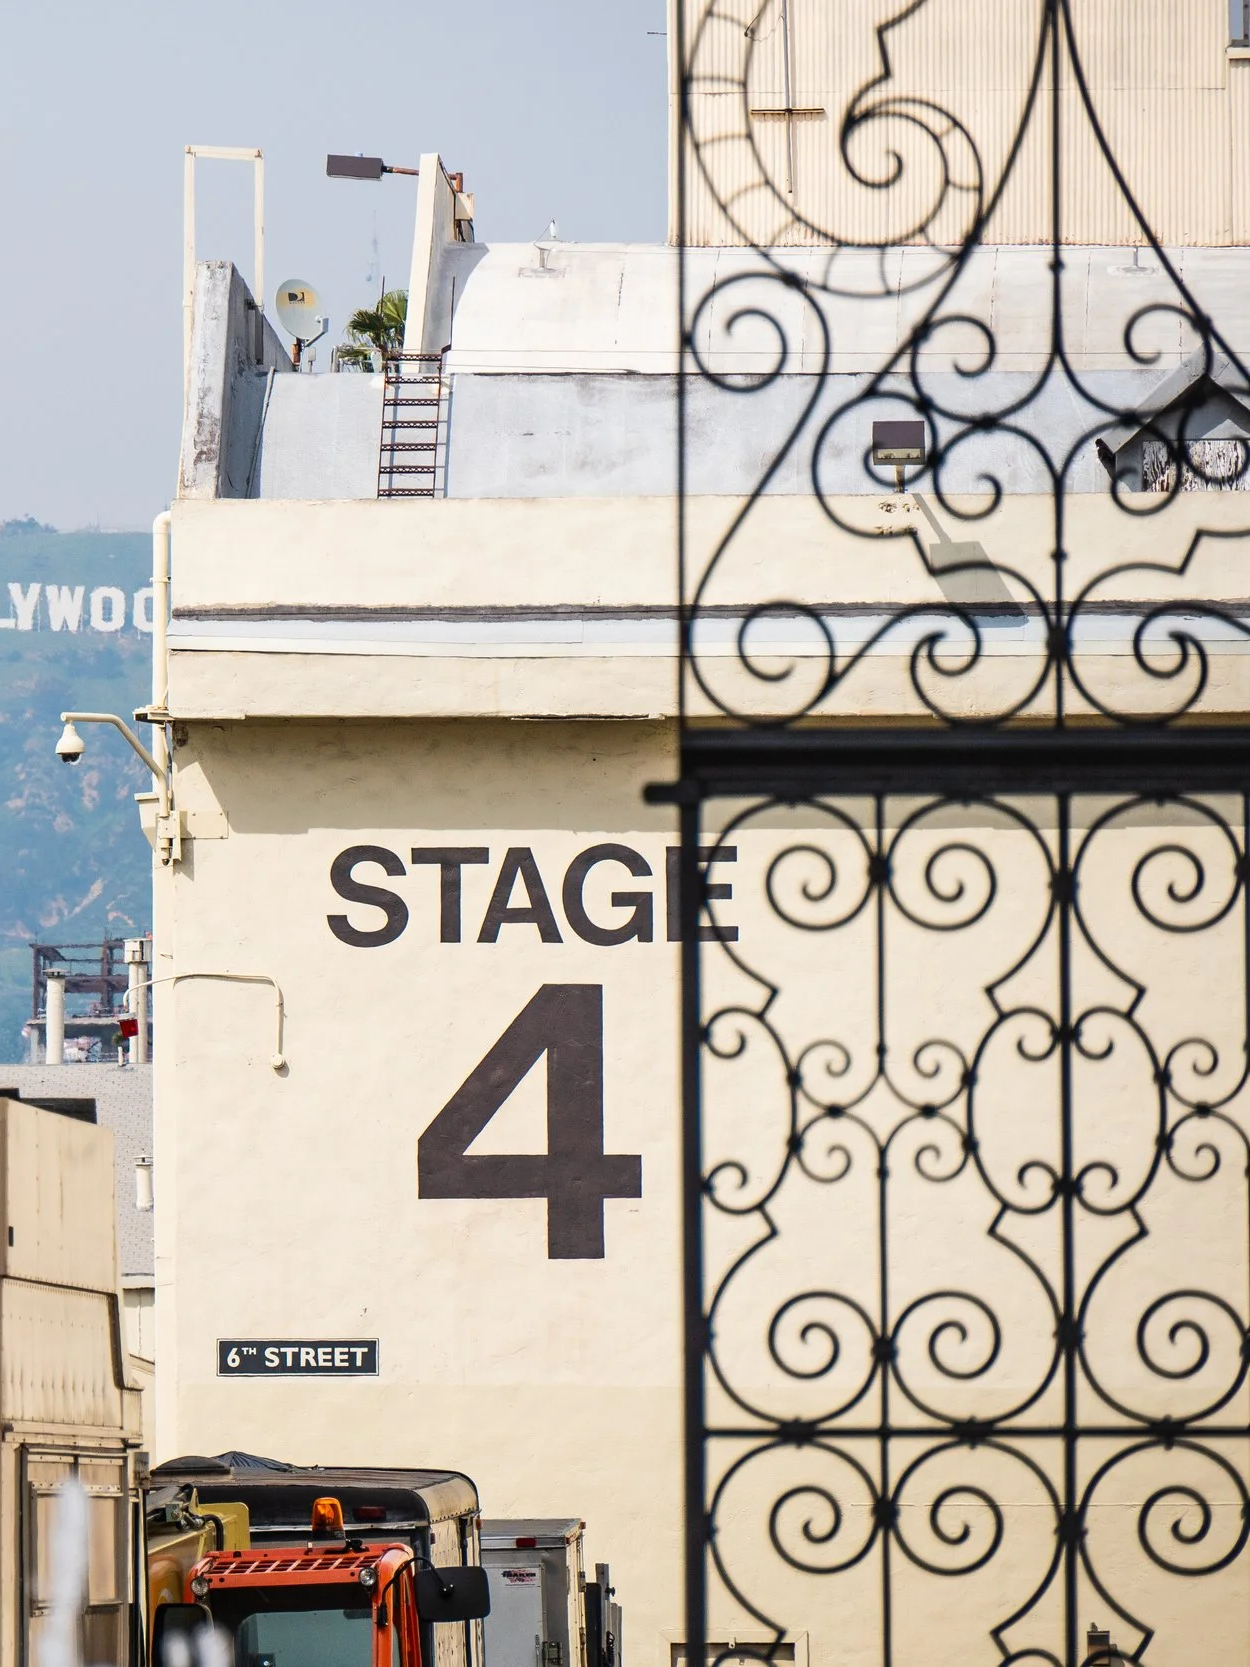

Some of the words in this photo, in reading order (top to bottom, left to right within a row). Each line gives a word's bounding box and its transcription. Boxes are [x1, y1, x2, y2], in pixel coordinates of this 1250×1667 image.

[327, 843, 739, 948] STAGE
[418, 984, 643, 1259] 4
[227, 1347, 257, 1368] 6TH
[264, 1347, 368, 1367] STREET
